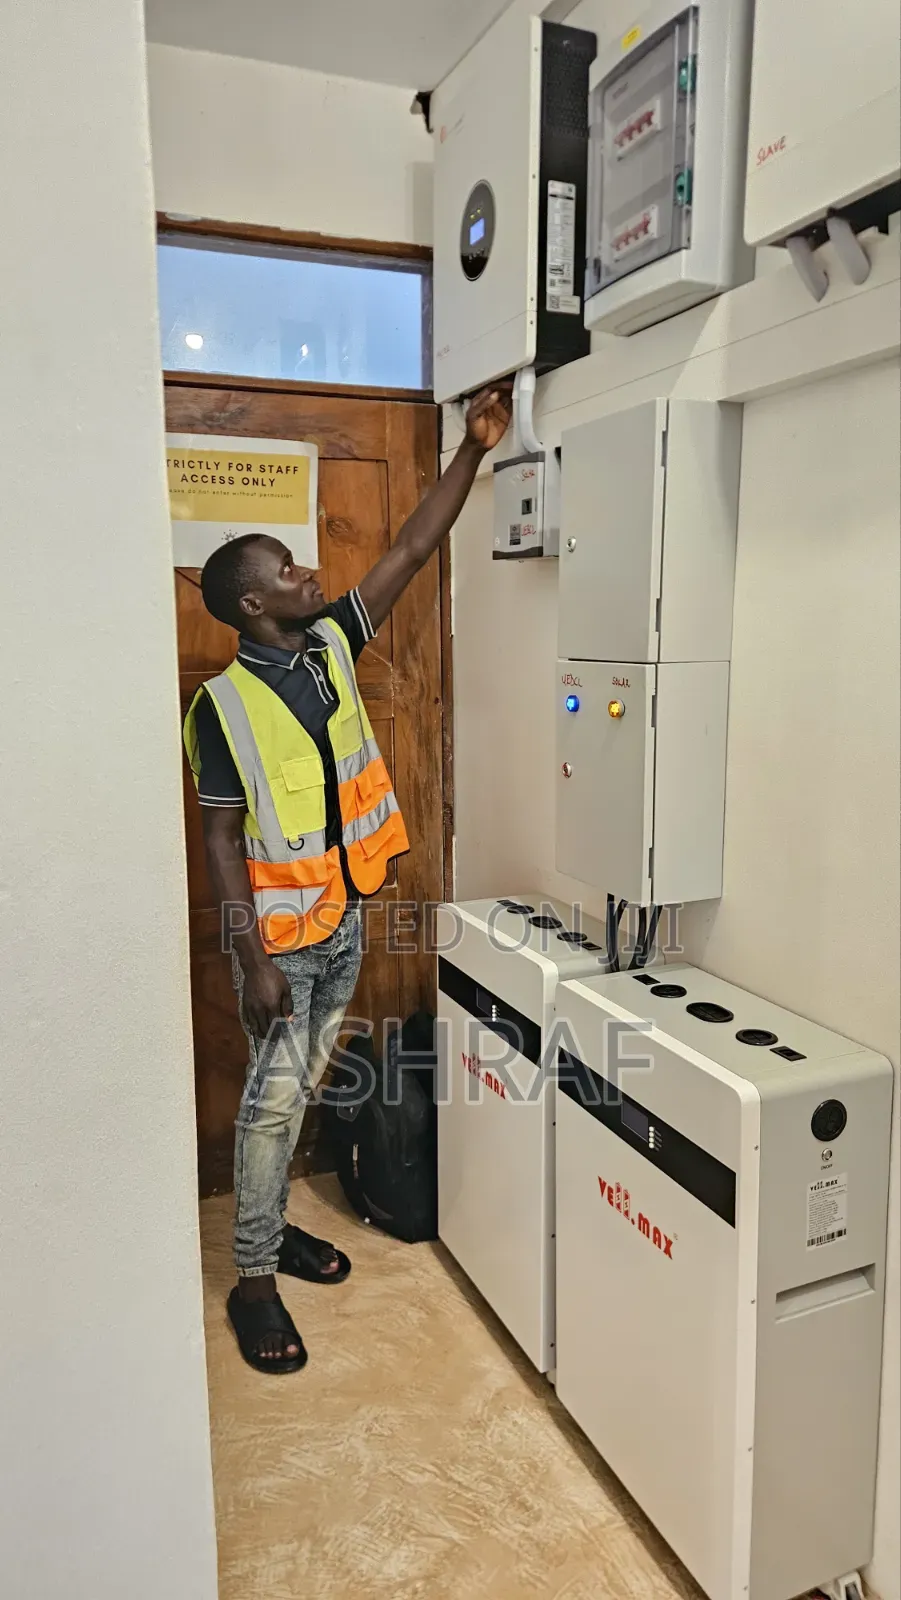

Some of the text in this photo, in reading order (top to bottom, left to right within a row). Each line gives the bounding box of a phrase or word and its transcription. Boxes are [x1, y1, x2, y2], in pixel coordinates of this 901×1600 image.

[757, 136, 786, 165] SLAVE
[166, 459, 299, 474] TRICTLY FOR STAFF
[180, 474, 275, 487] ACCESS ONLY
